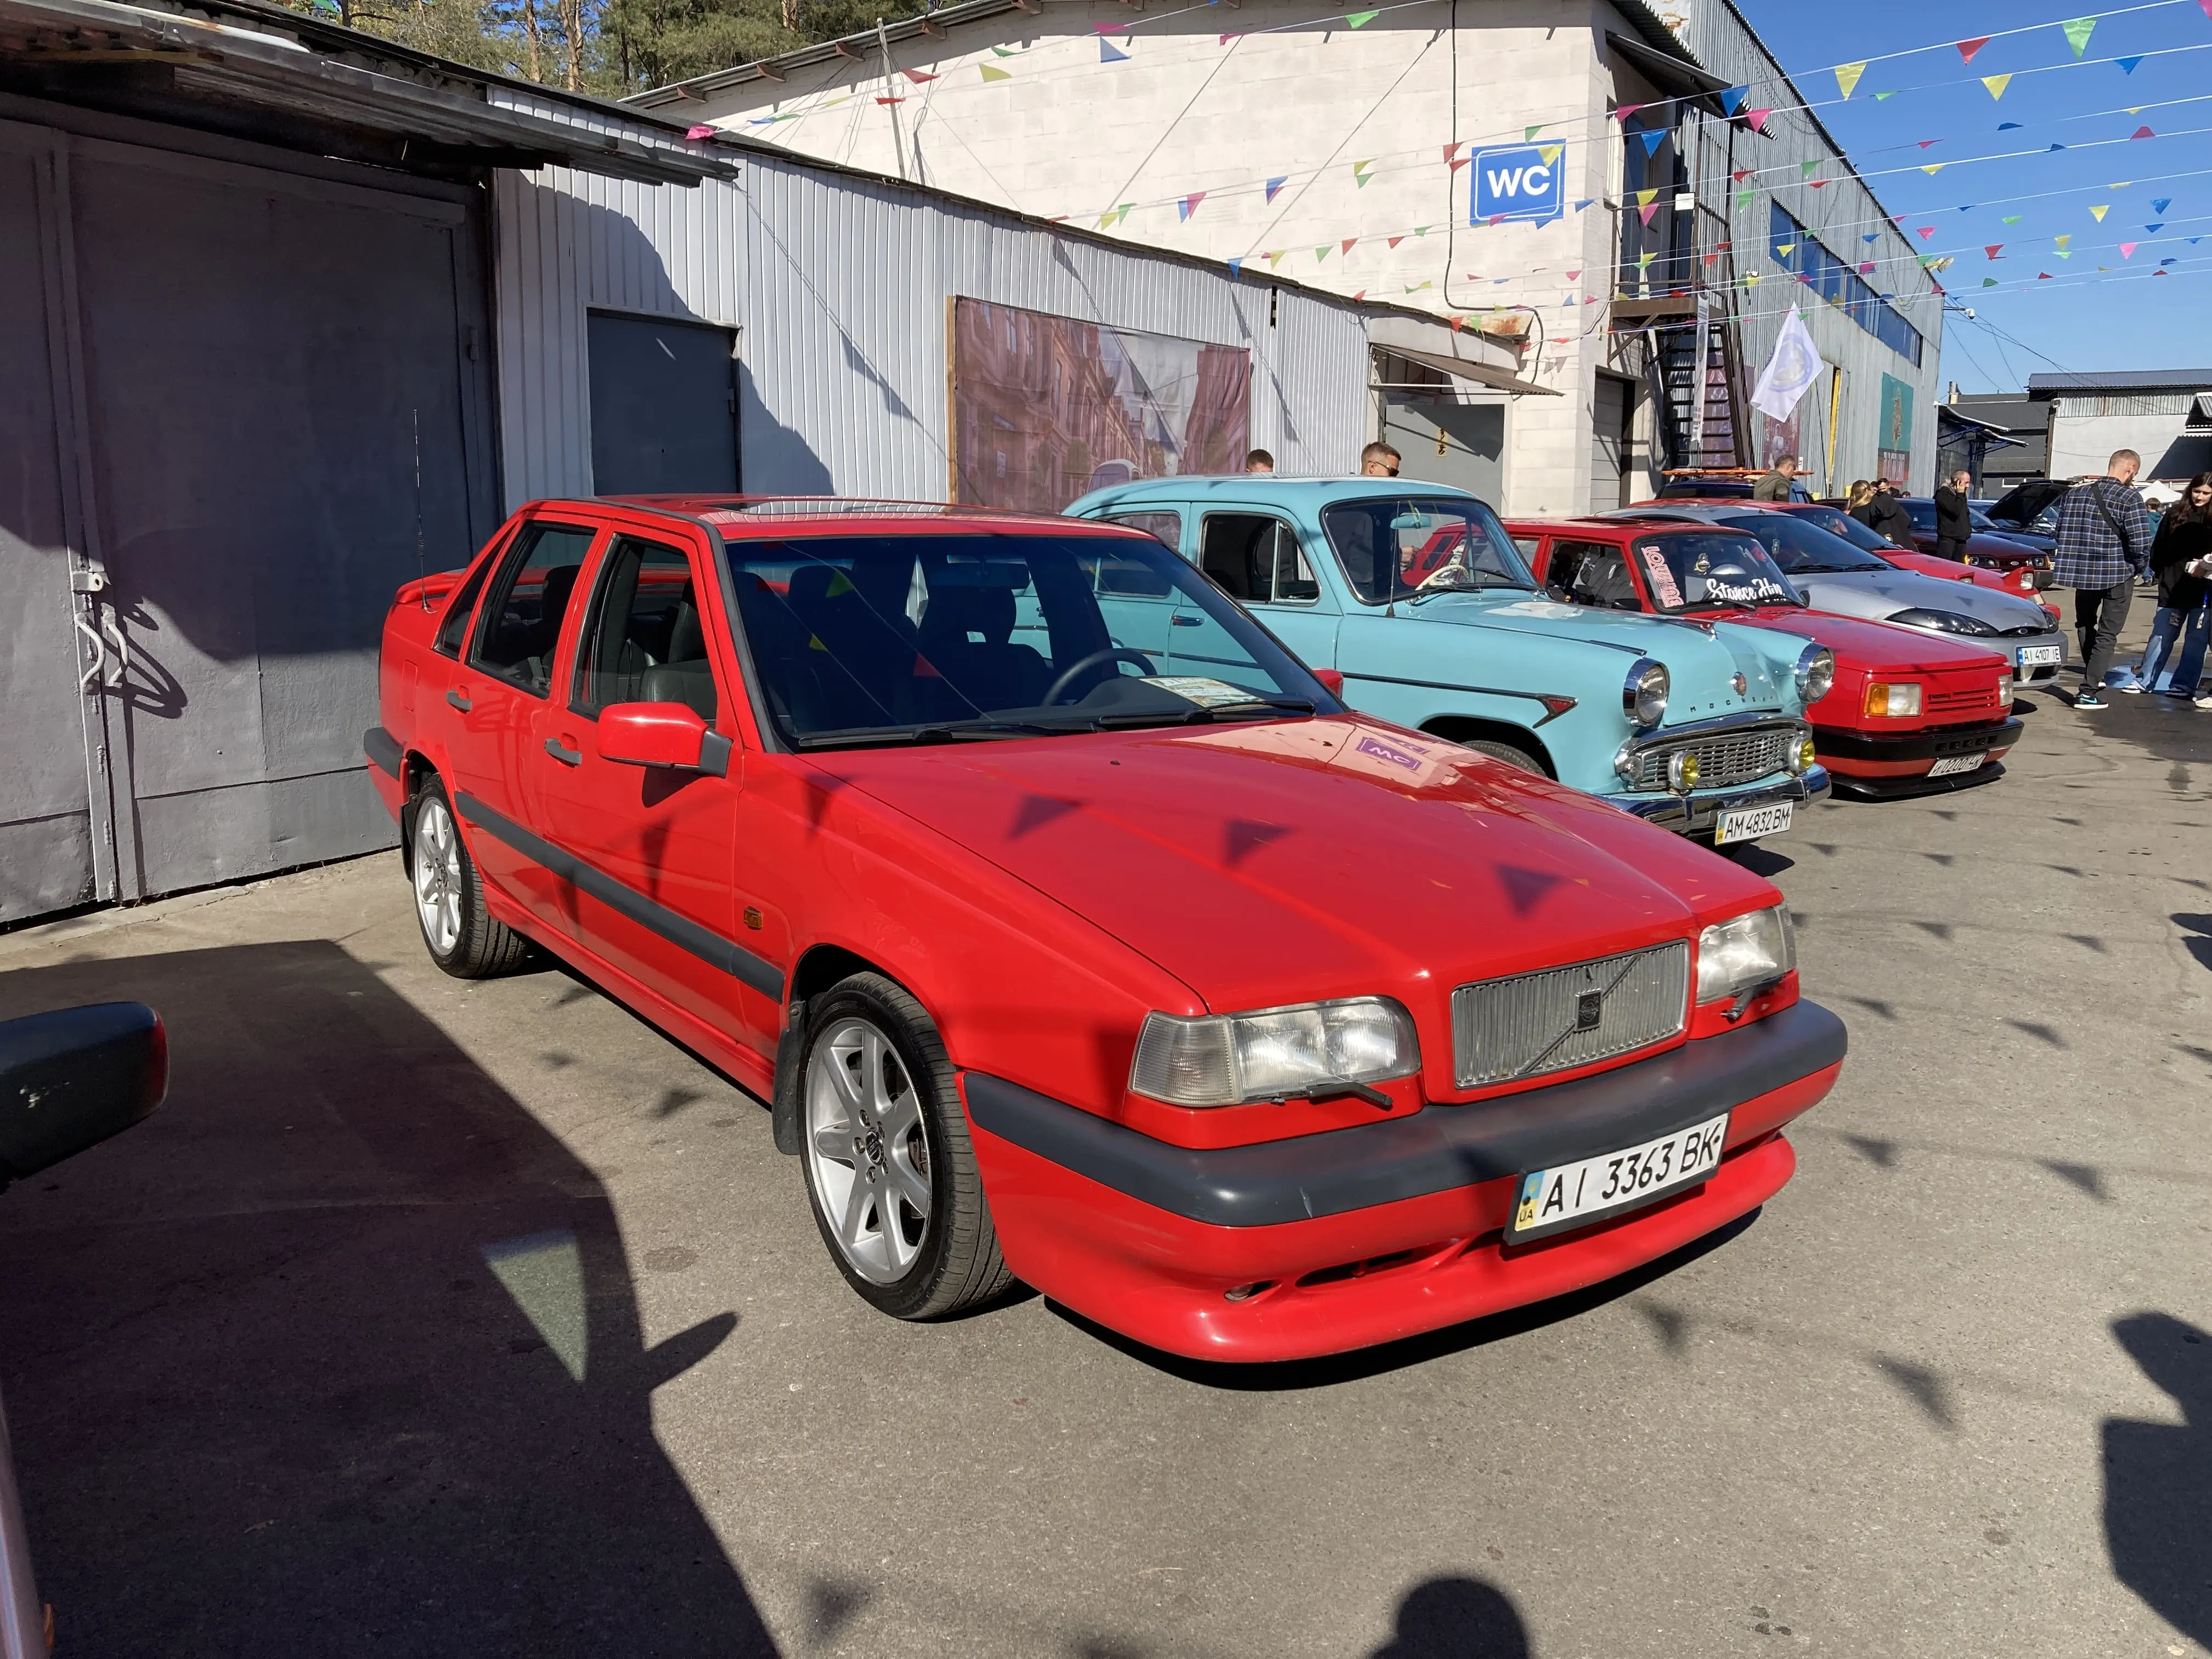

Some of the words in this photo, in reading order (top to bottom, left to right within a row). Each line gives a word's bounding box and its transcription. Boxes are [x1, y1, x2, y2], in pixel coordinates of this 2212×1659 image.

[1487, 165, 1550, 198] WC
[2035, 649, 2049, 661] 4107
[1941, 757, 1968, 774] 0200
[1724, 815, 1745, 839] AM
[1746, 810, 1773, 835] 4832
[1772, 806, 1791, 830] BM
[1542, 1167, 1587, 1217] AI
[1601, 1141, 1675, 1200] 3363
[1679, 1122, 1722, 1173] BK
[1519, 1208, 1533, 1222] UA
